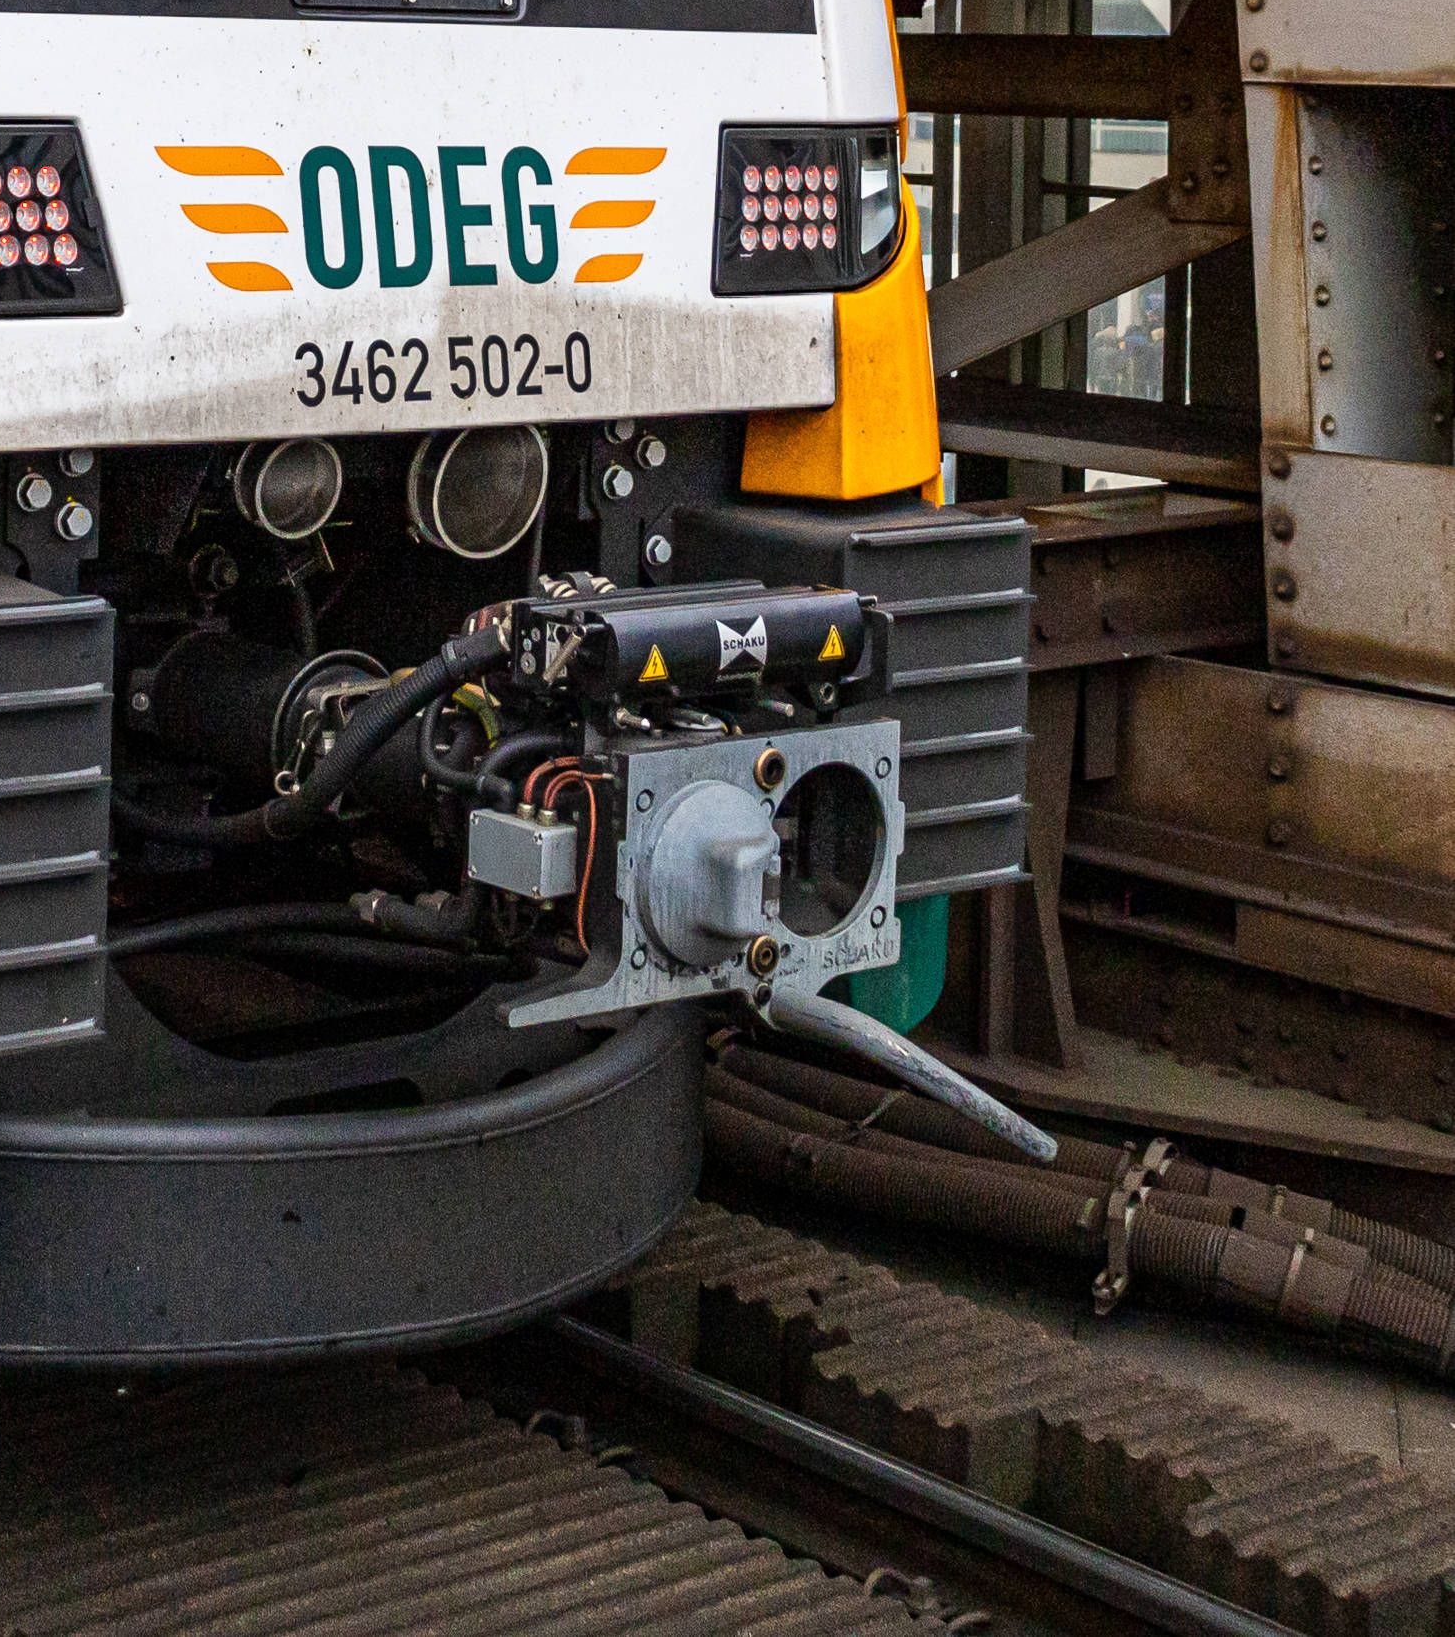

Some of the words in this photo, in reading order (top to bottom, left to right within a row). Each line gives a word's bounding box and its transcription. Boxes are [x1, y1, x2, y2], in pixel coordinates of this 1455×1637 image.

[299, 145, 559, 289] ODEG
[294, 338, 432, 407] 3462
[447, 331, 592, 399] 502-0
[723, 634, 766, 650] SCHAKU
